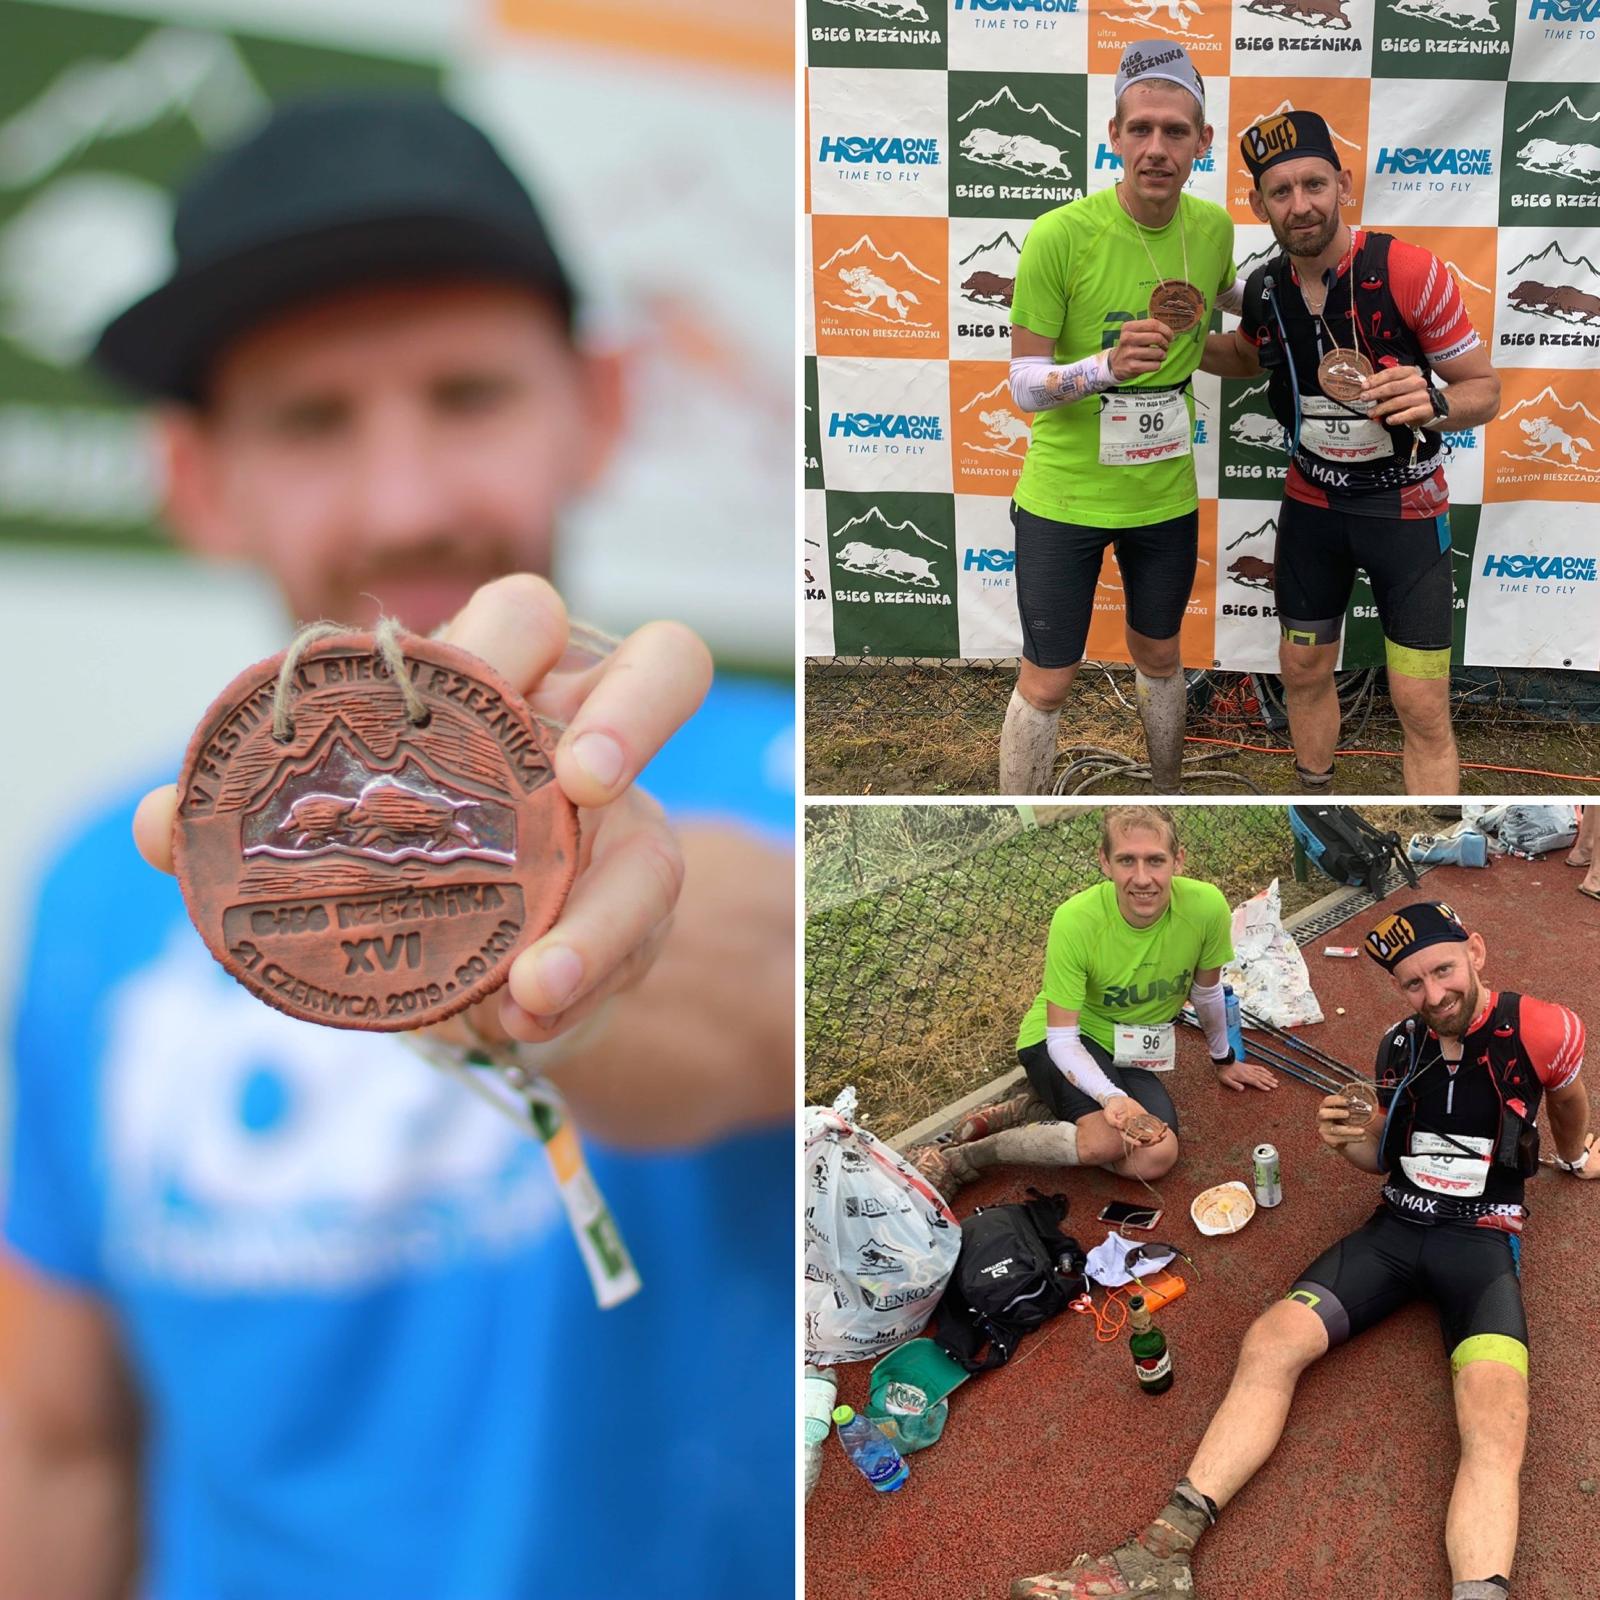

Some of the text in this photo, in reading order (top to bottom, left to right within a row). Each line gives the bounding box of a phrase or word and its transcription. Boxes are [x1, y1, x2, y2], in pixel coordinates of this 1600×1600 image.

[975, 19, 1057, 30] TIME TO FLY
[1097, 29, 1116, 37] ultra
[1544, 29, 1596, 40] TIME TO
[1097, 41, 1133, 49] MARA
[819, 136, 937, 164] HOKA ONE
[906, 152, 939, 165] ONE
[1375, 147, 1491, 175] HOKA ONE
[1459, 162, 1493, 175] ONE
[838, 170, 920, 182] TIME TO FLY
[1391, 182, 1472, 192] TIME TO FLY
[821, 328, 940, 339] MARATON BIESZCZADZKI
[828, 413, 939, 439] HOKA ONE
[1139, 412, 1164, 433] 96
[910, 428, 943, 441] ONE
[848, 444, 925, 455] TIME TO FLY
[961, 468, 1010, 477] MARATON
[1312, 464, 1350, 487] MAX
[1497, 474, 1540, 483] MARATON
[1483, 555, 1595, 580] HOKA ONE
[1564, 569, 1597, 581] ONE
[982, 578, 1010, 587] TIME
[1500, 584, 1576, 594] TIME TO FLY
[428, 669, 548, 785] RZEŹNIKA
[341, 931, 421, 975] XVI
[230, 920, 520, 1018] 21 CZERWCA 2019 80 KM
[1142, 1034, 1160, 1050] 96
[1401, 1194, 1438, 1213] MAX
